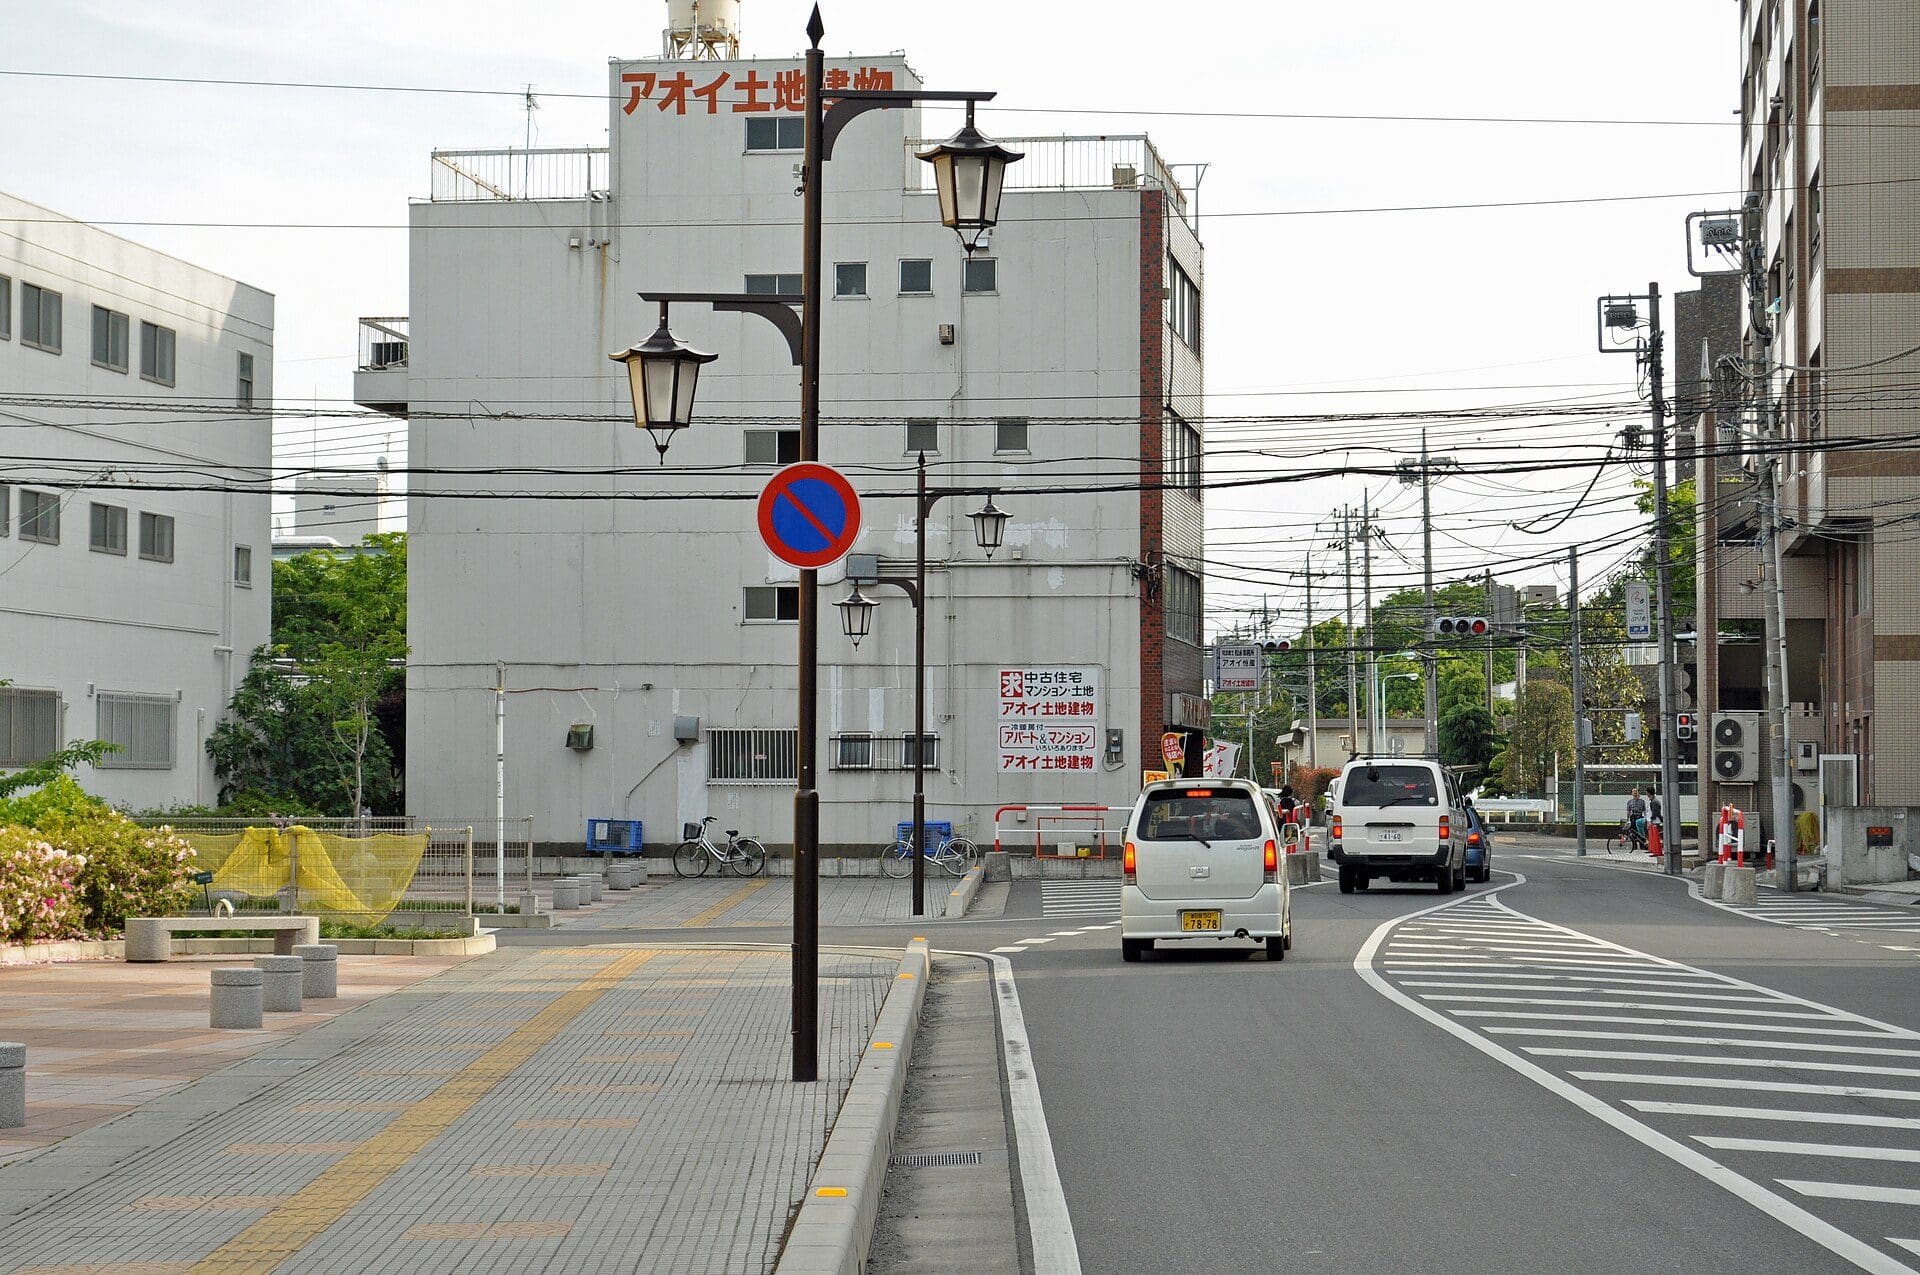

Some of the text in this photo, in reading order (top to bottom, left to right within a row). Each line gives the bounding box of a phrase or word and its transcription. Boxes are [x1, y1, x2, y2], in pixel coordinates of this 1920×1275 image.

[1001, 671, 1023, 697] 求
[1024, 671, 1082, 683] 中古住宅
[1002, 702, 1094, 716] アオイ土地建物
[1035, 744, 1084, 752] いろいろあります
[1002, 755, 1094, 769] アオイ土地建物
[1203, 752, 1214, 777] アオ
[1190, 919, 1218, 930] 78-78
